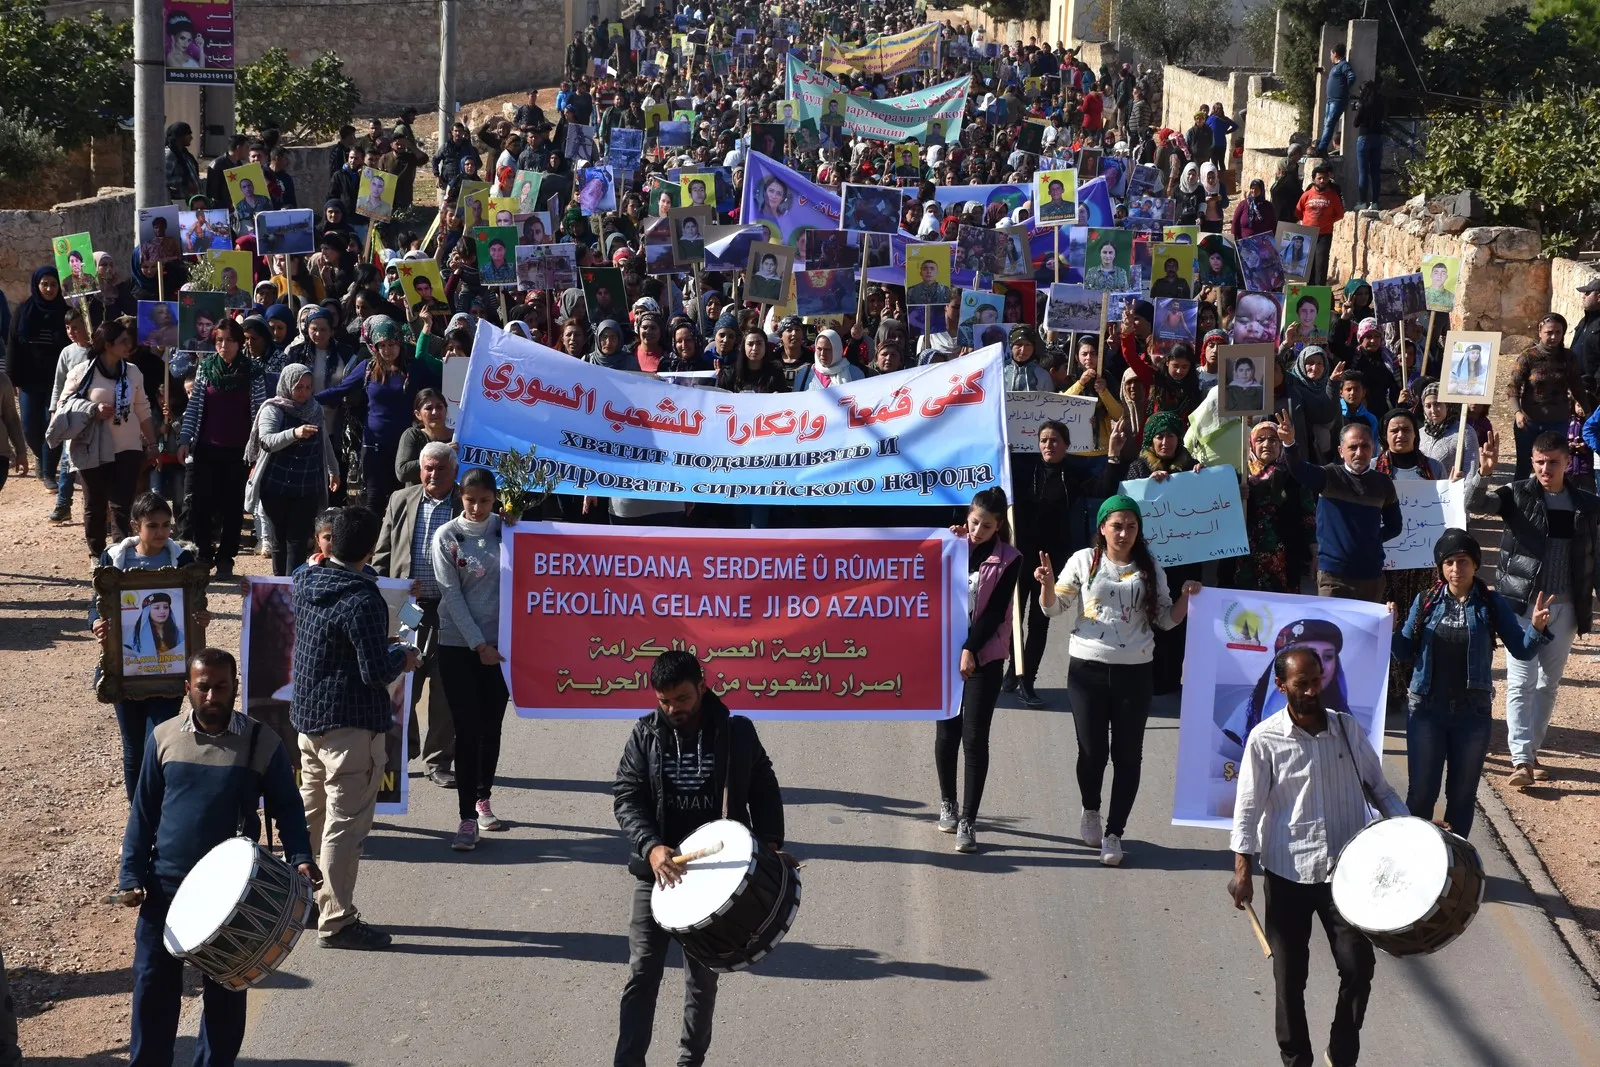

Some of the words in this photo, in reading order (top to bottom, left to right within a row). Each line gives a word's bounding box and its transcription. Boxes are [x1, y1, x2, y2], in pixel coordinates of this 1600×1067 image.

[793, 68, 831, 88] التركي
[481, 360, 597, 416] السوري
[920, 366, 987, 419] كفى
[603, 396, 706, 437] للشعب
[839, 386, 913, 430] قمعاً
[715, 403, 827, 446] وإنكاراً
[559, 429, 667, 464] хватит
[674, 442, 870, 473] подавливать
[460, 444, 684, 495] игорировать
[690, 473, 873, 498] сирийского
[883, 461, 994, 498] народа
[1142, 501, 1171, 518] الأم
[1173, 494, 1232, 518] عاشت
[1144, 519, 1220, 545] الديمقراطي
[533, 552, 692, 580] BERXWEDANA
[702, 552, 807, 580] SERDEMÊ
[812, 554, 829, 580] Û
[834, 553, 925, 581] RÛMETÊ
[526, 588, 646, 618] PÊKOLÎNA
[651, 592, 752, 619] GELAN.E
[761, 594, 780, 620] JI
[787, 594, 821, 619] BO
[825, 590, 930, 620] AZADIYÊ
[588, 636, 698, 663] والكرامة
[700, 637, 766, 664] العصر
[770, 637, 868, 665] مقاومة
[555, 668, 649, 696] الحرية
[715, 673, 741, 698] من
[745, 669, 830, 698] الشعوب
[833, 672, 902, 698] إصرار
